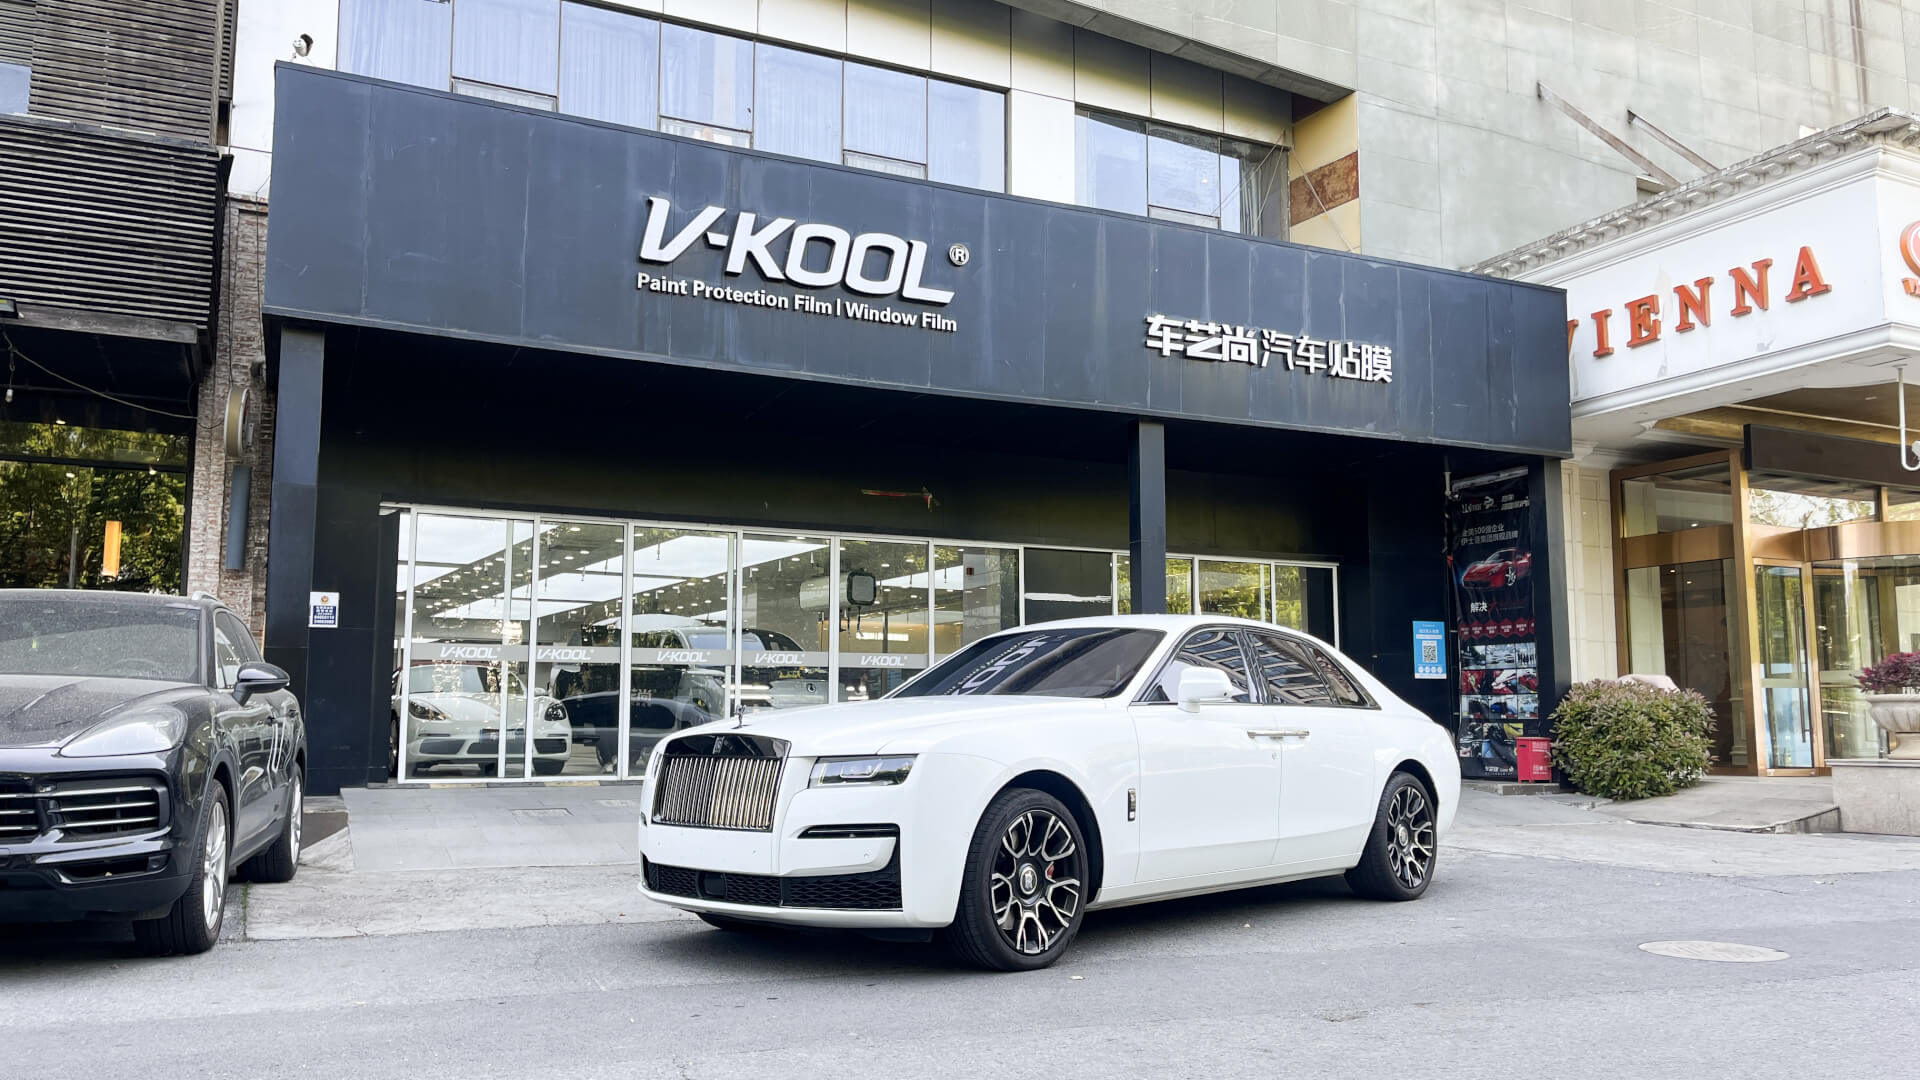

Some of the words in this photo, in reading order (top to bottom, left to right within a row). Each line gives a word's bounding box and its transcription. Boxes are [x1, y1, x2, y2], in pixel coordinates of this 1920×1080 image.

[640, 196, 955, 304] V-KOOL
[637, 272, 688, 295] Paint
[693, 280, 789, 309] Protection
[794, 294, 832, 314] Film
[845, 301, 918, 326] Window
[921, 312, 957, 332] Film
[440, 646, 498, 660] V-KOOL
[537, 648, 592, 661] V-KOOL
[656, 651, 708, 663] V-KOOL
[754, 652, 803, 664] V-KOOL
[860, 655, 905, 666] V-KOOL
